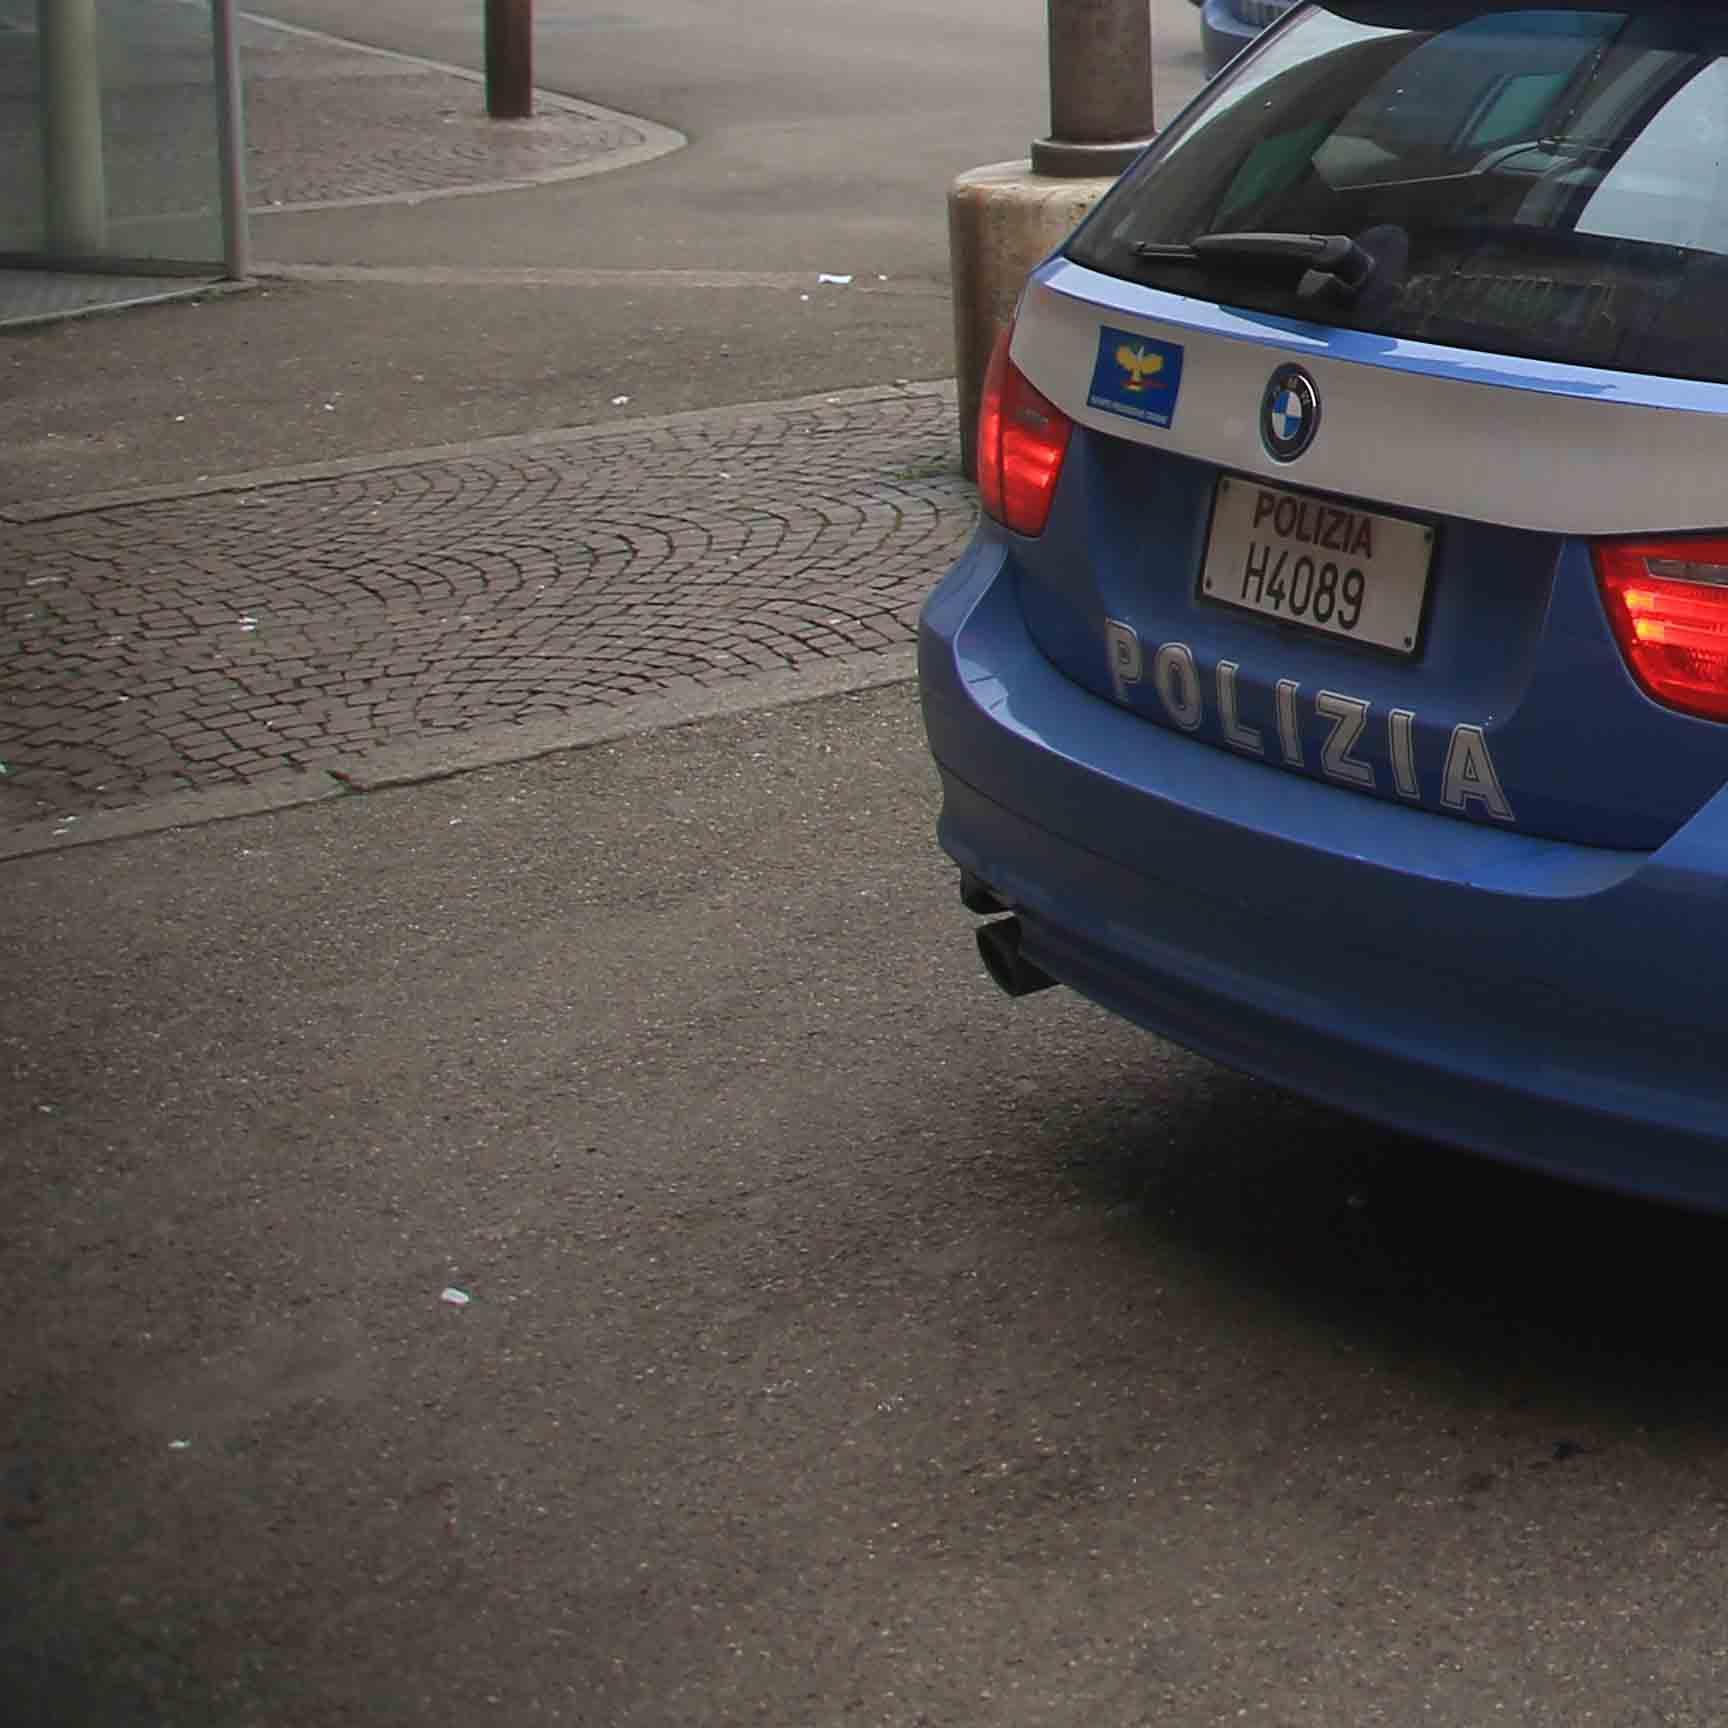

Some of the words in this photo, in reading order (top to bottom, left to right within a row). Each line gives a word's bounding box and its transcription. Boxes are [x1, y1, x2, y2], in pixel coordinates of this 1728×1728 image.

[1252, 490, 1373, 560] POLIZIA
[1240, 541, 1367, 631] H4089
[1105, 616, 1516, 822] POLIZIA
